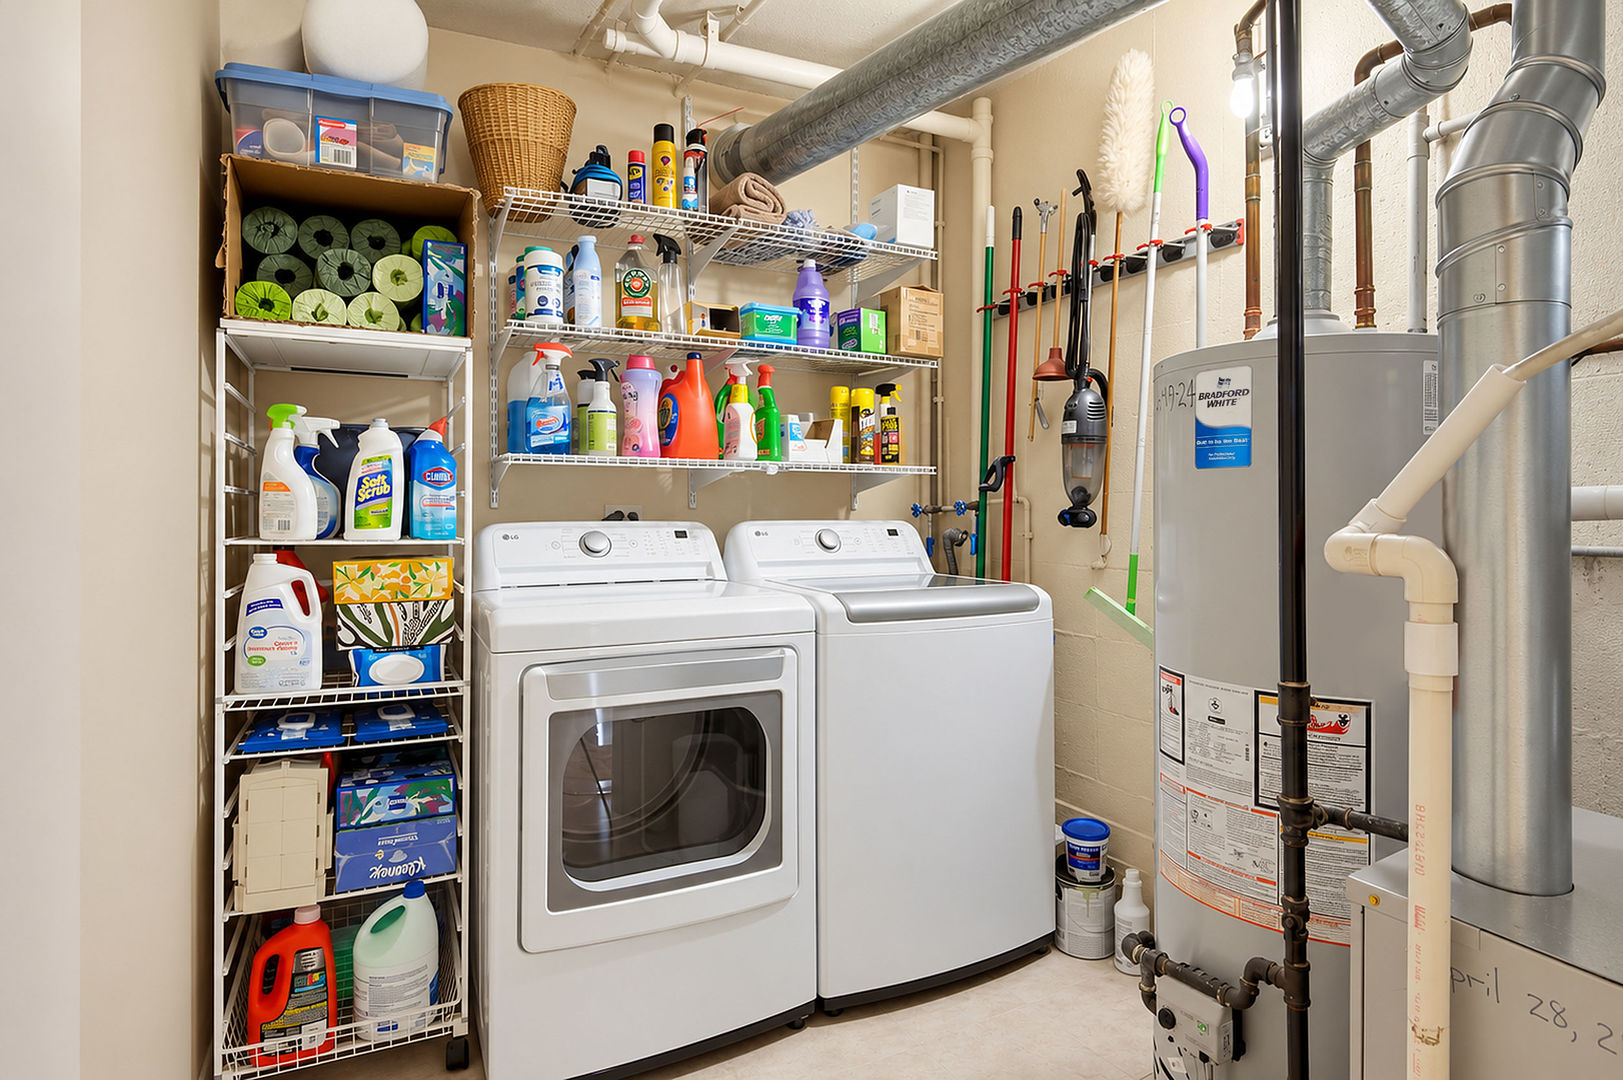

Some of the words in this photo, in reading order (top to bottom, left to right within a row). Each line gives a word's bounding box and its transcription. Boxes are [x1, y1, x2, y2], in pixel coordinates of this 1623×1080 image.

[1198, 389, 1249, 401] BRADFORD
[1207, 399, 1237, 408] WHITE
[361, 474, 387, 489] Soft
[357, 485, 391, 502] Scrub
[369, 856, 426, 879] Kleenex
[1450, 966, 1500, 1004] pril
[1527, 993, 1578, 1043] 28,
[1596, 1022, 1623, 1055] 2
